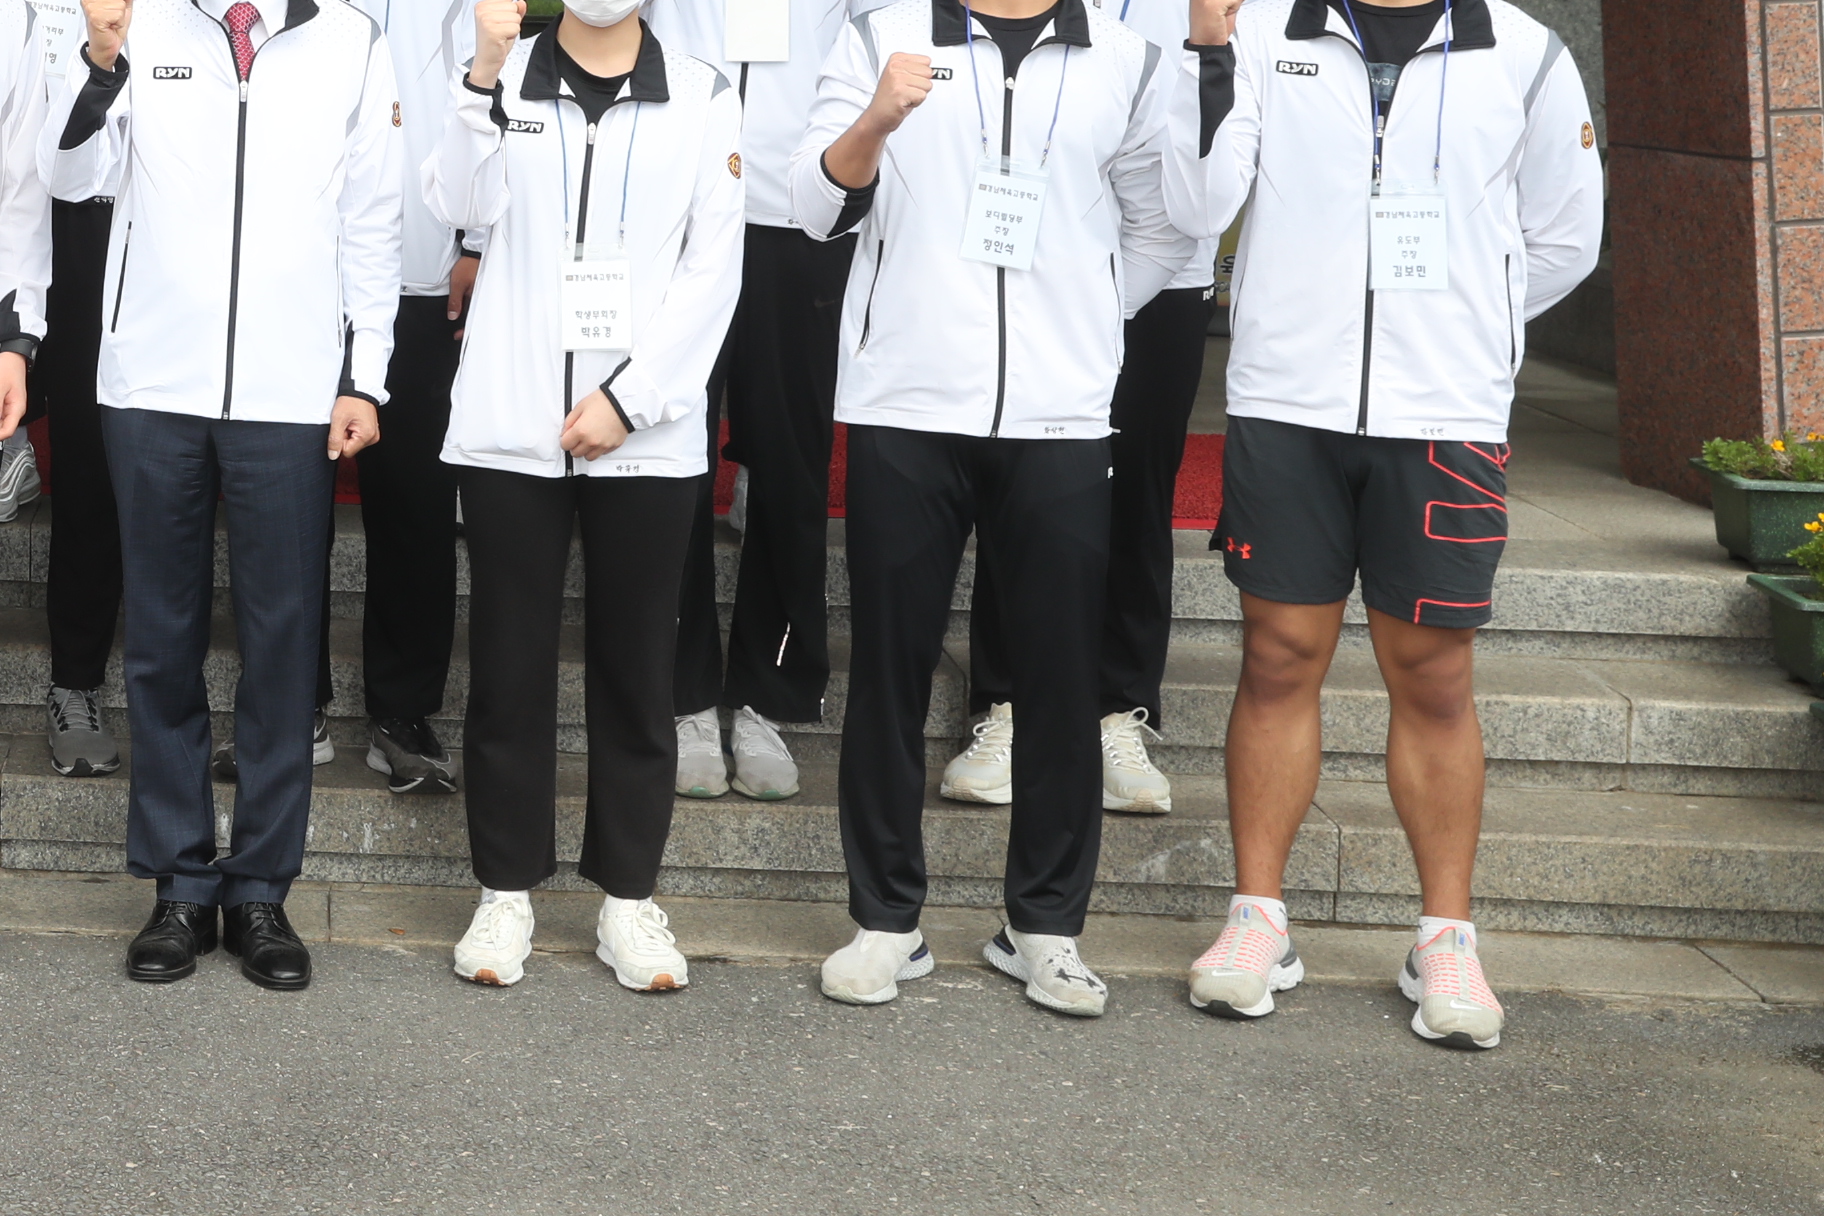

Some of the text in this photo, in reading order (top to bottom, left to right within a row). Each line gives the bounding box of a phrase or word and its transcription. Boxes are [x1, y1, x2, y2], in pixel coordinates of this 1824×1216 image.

[155, 68, 190, 78] RYN
[1279, 62, 1316, 74] RYN
[509, 121, 541, 132] RYN
[1384, 211, 1439, 219] 경남체육고등학교
[995, 226, 1009, 236] 주장
[1397, 236, 1420, 244] 유도부
[983, 239, 1014, 255] 정인석
[1402, 251, 1417, 259] 주장
[1393, 266, 1426, 277] 김보민
[576, 310, 617, 319] 학생부회장
[582, 327, 611, 338] 박유경
